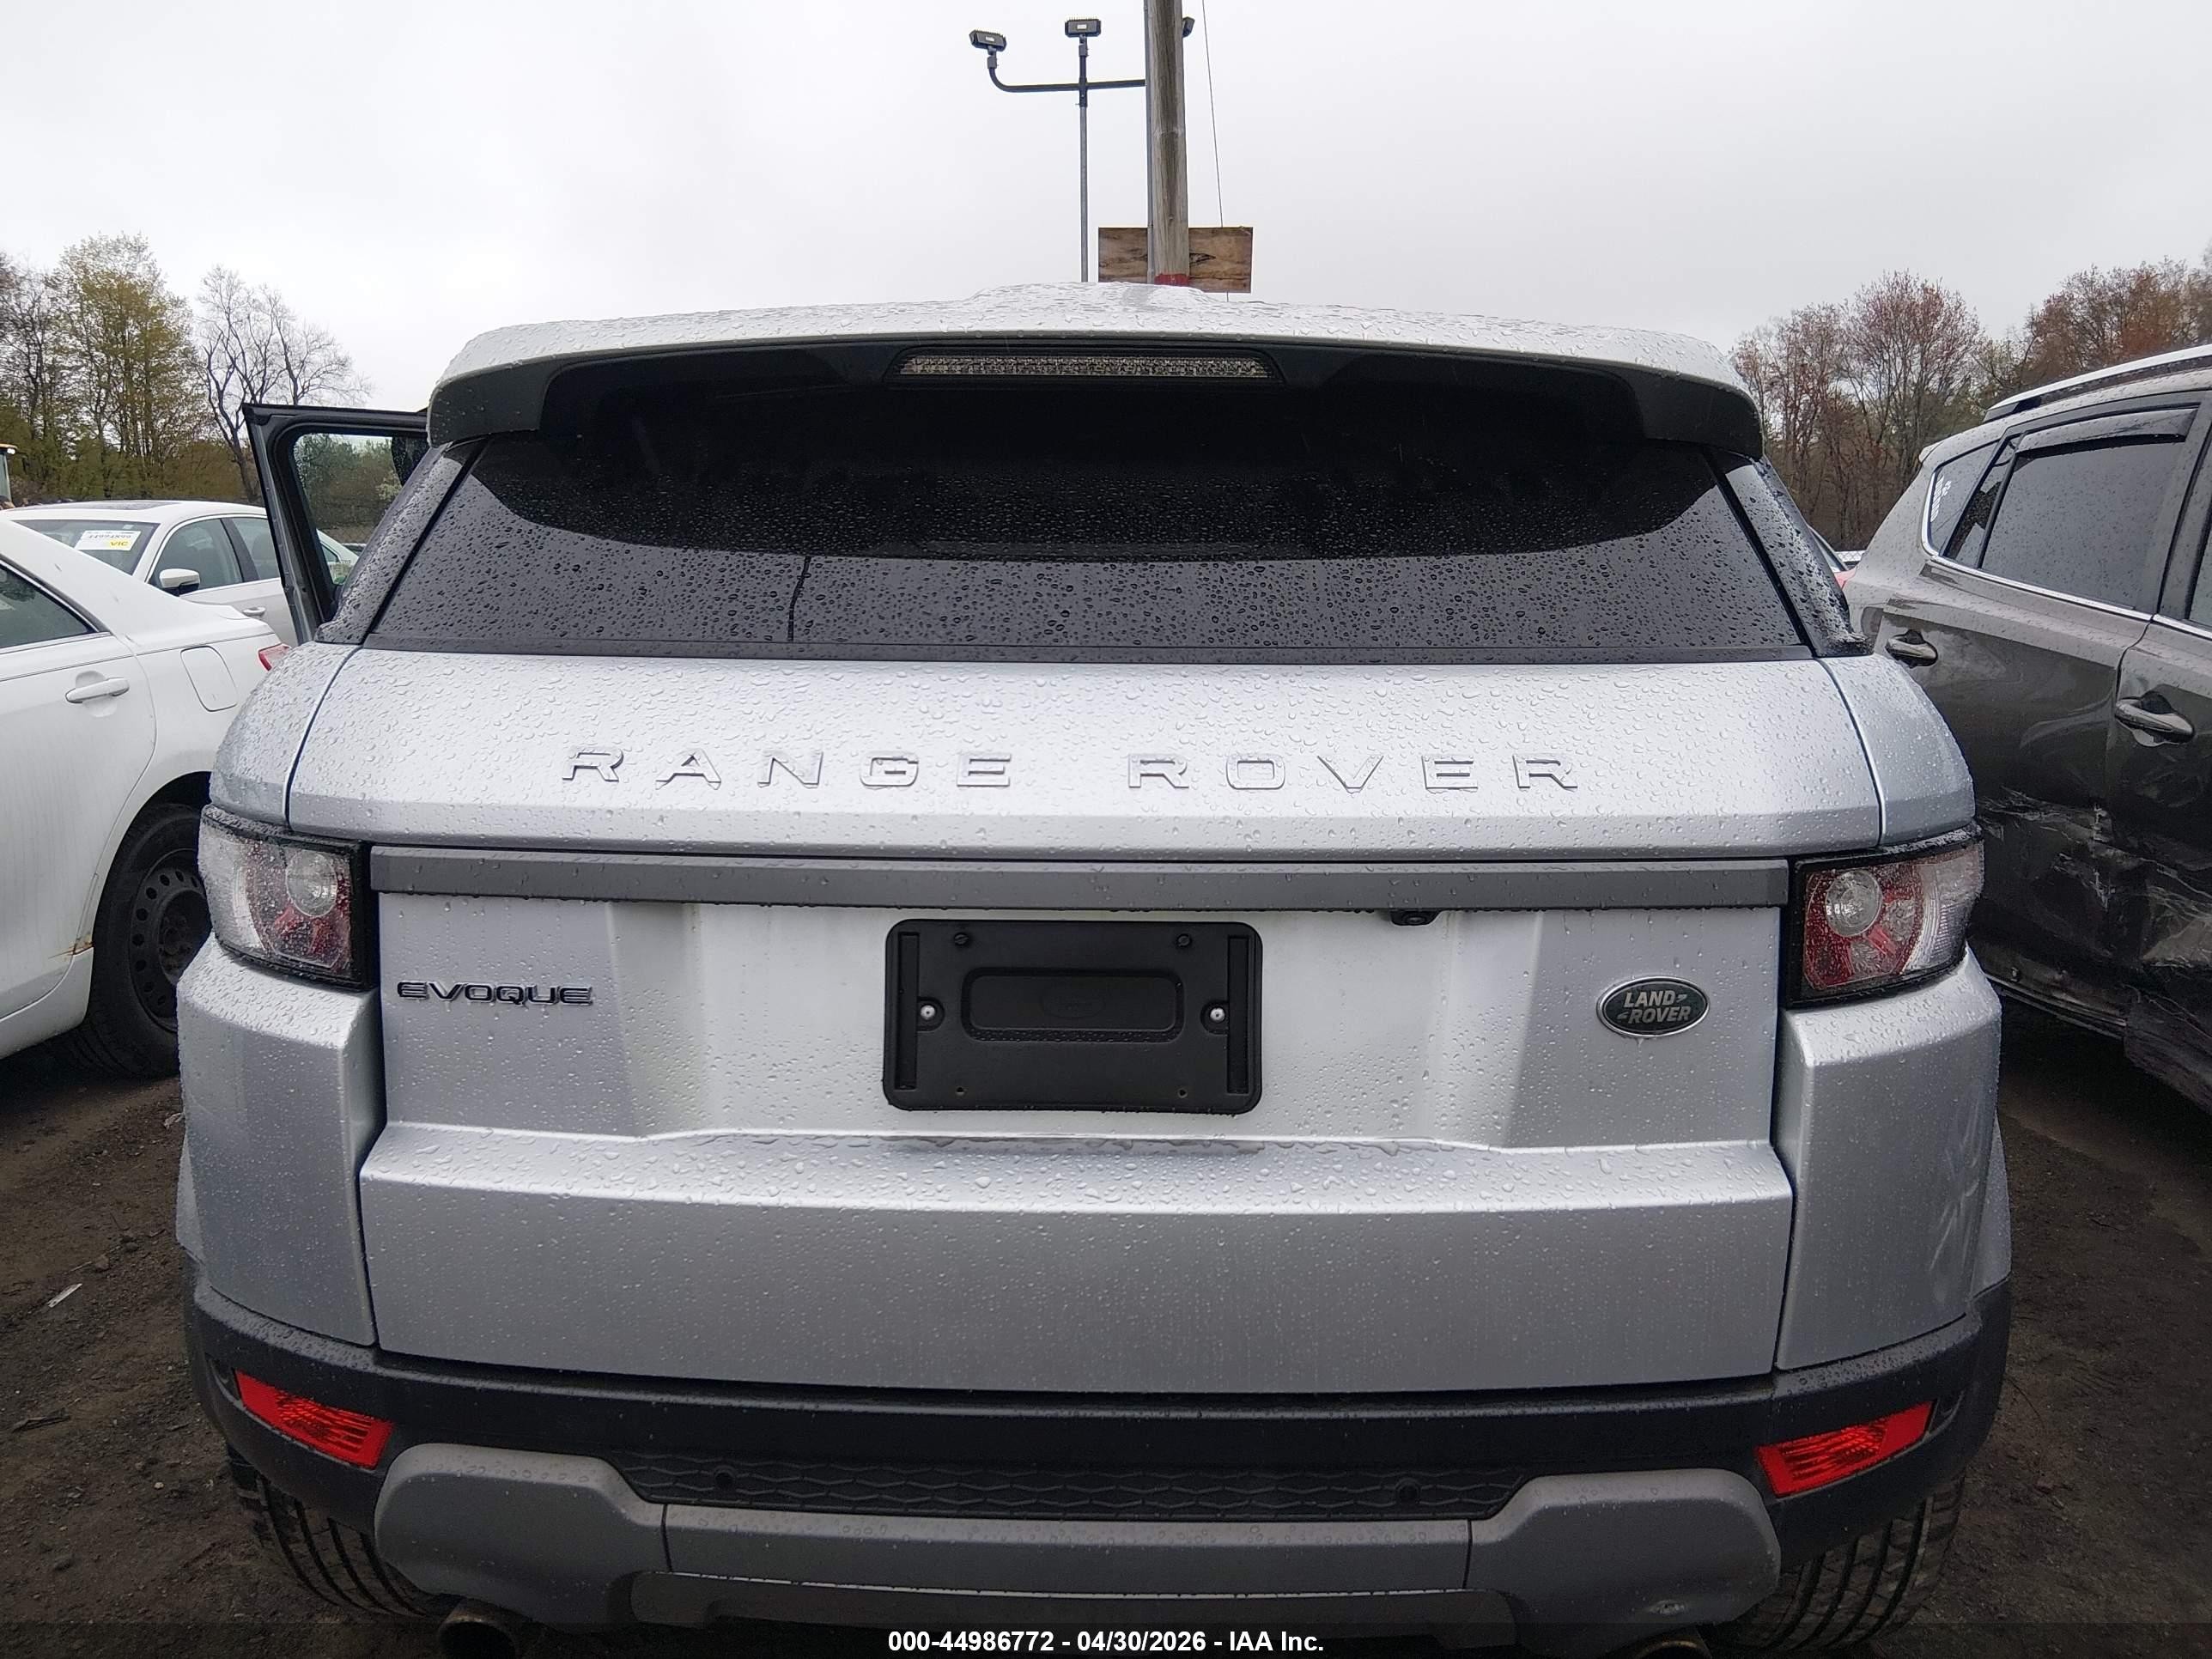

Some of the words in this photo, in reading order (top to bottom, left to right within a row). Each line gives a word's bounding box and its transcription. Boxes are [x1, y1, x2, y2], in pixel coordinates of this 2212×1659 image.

[562, 748, 1012, 789] RANGE
[1127, 753, 1578, 793] ROVER
[397, 980, 593, 1007] EVOQUE
[1623, 990, 1676, 1008] LAND
[1628, 1006, 1692, 1024] ROVER
